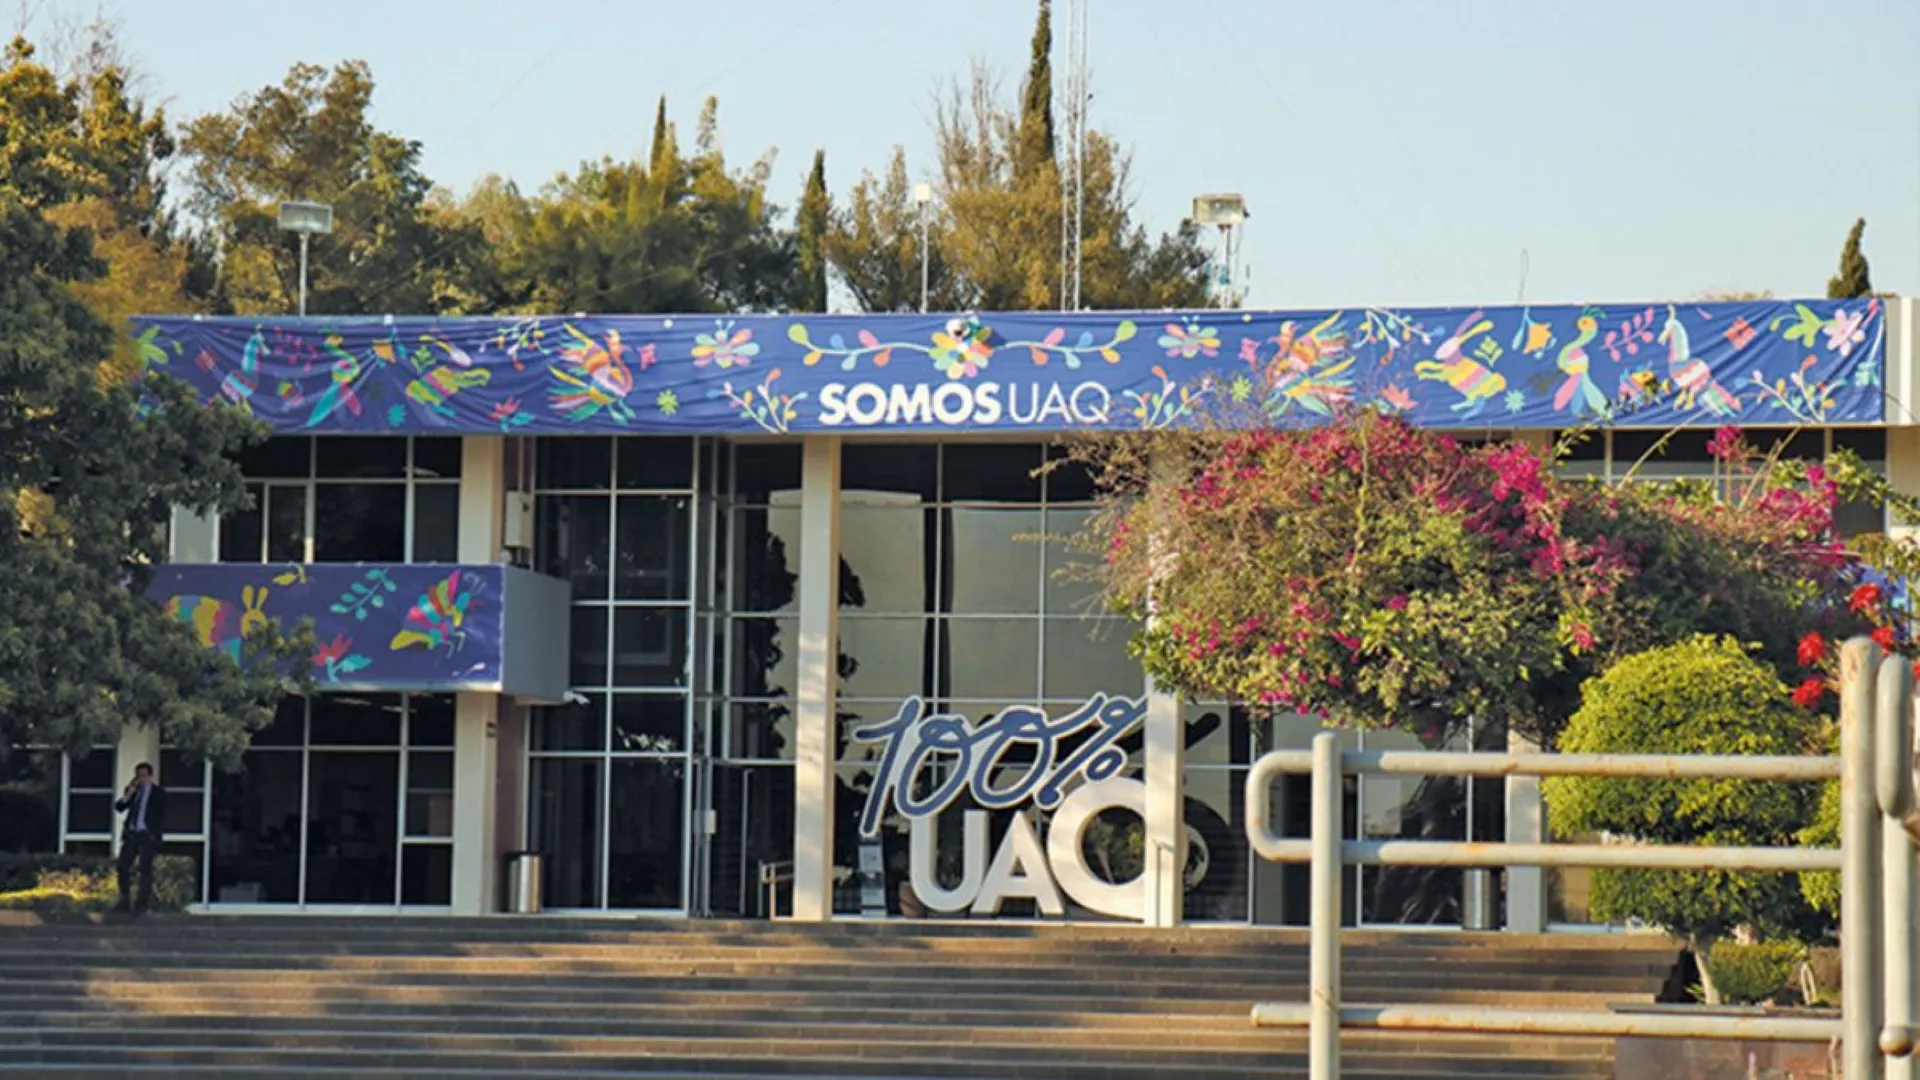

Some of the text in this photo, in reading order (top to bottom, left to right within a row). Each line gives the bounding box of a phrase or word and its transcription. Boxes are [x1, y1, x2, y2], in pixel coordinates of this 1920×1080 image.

[819, 382, 1112, 424] SOMOS UAQ
[856, 692, 1146, 837] 100%
